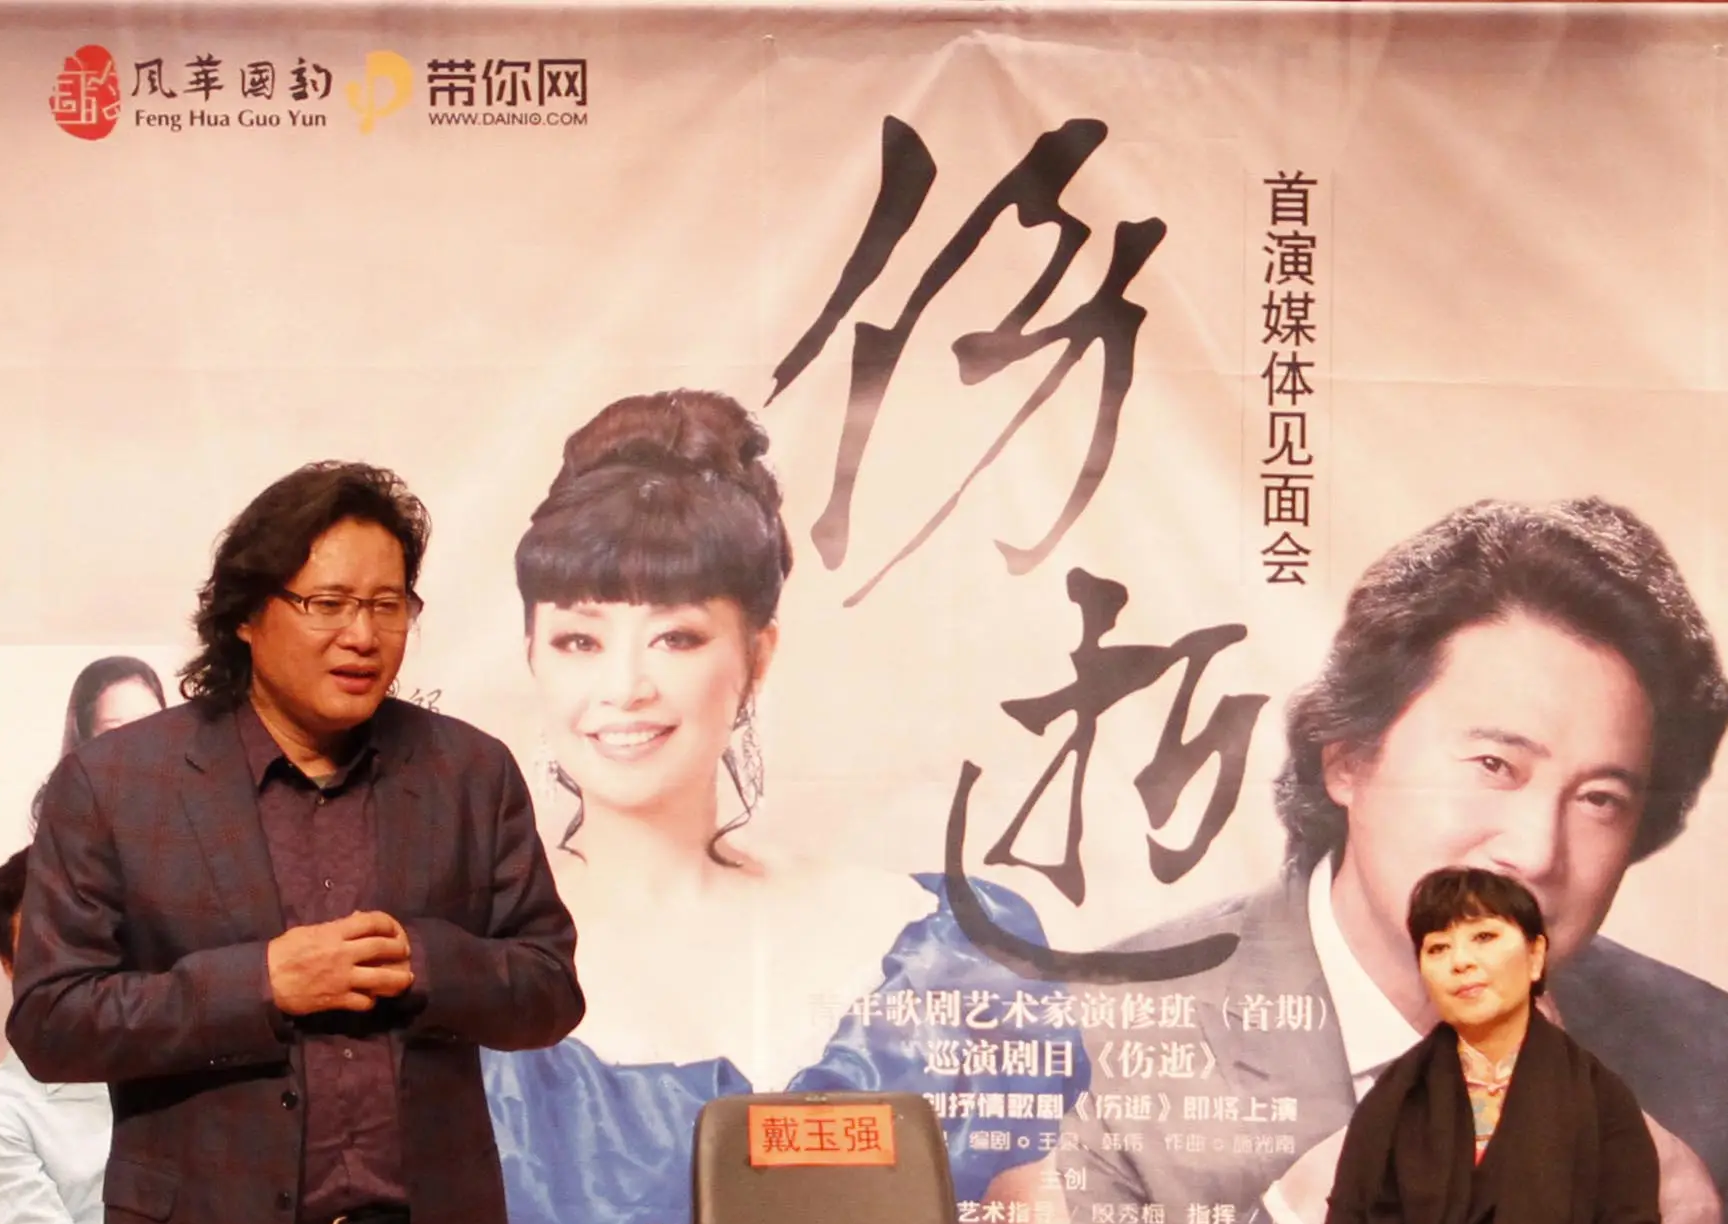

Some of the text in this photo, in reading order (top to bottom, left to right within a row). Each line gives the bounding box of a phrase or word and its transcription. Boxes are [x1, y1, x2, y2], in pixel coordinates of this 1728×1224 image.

[427, 58, 588, 107] 带你网
[135, 109, 327, 132] Feng Hua Guo Yun
[1261, 171, 1318, 586] 首演媒体见面会
[924, 1040, 1217, 1079] 巡演剧目《伤逝》
[761, 1116, 882, 1154] 戴玉强
